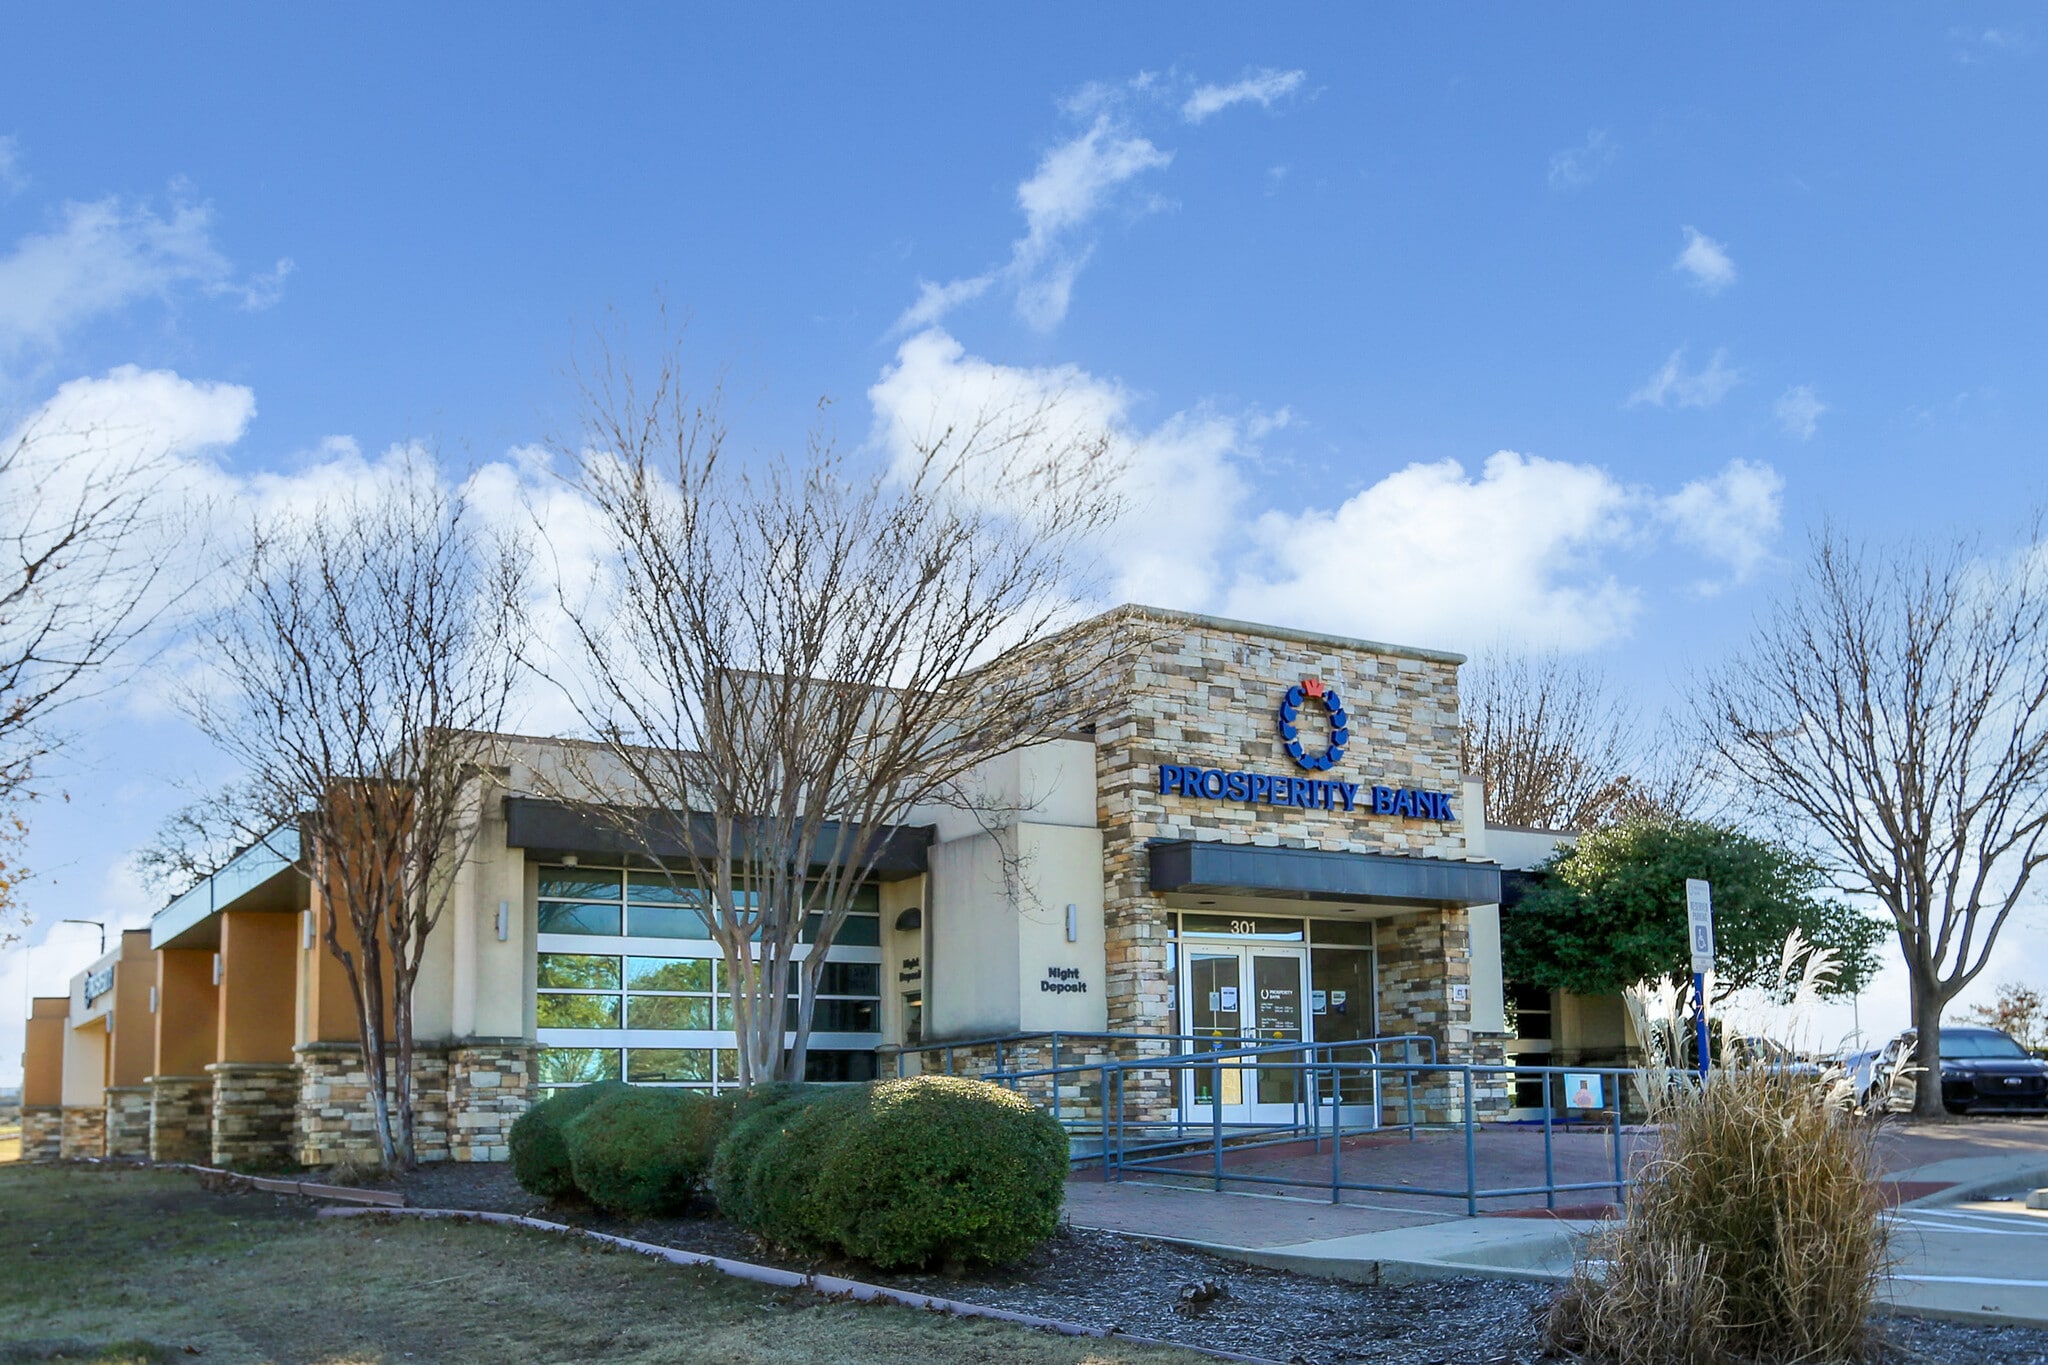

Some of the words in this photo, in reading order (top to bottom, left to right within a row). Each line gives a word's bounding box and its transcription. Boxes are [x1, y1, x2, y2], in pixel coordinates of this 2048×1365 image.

[1159, 764, 1359, 811] PROSPERITY
[1371, 786, 1455, 821] BANK
[1231, 920, 1255, 934] 301
[1048, 967, 1079, 980] Night
[1041, 980, 1087, 994] Deposit
